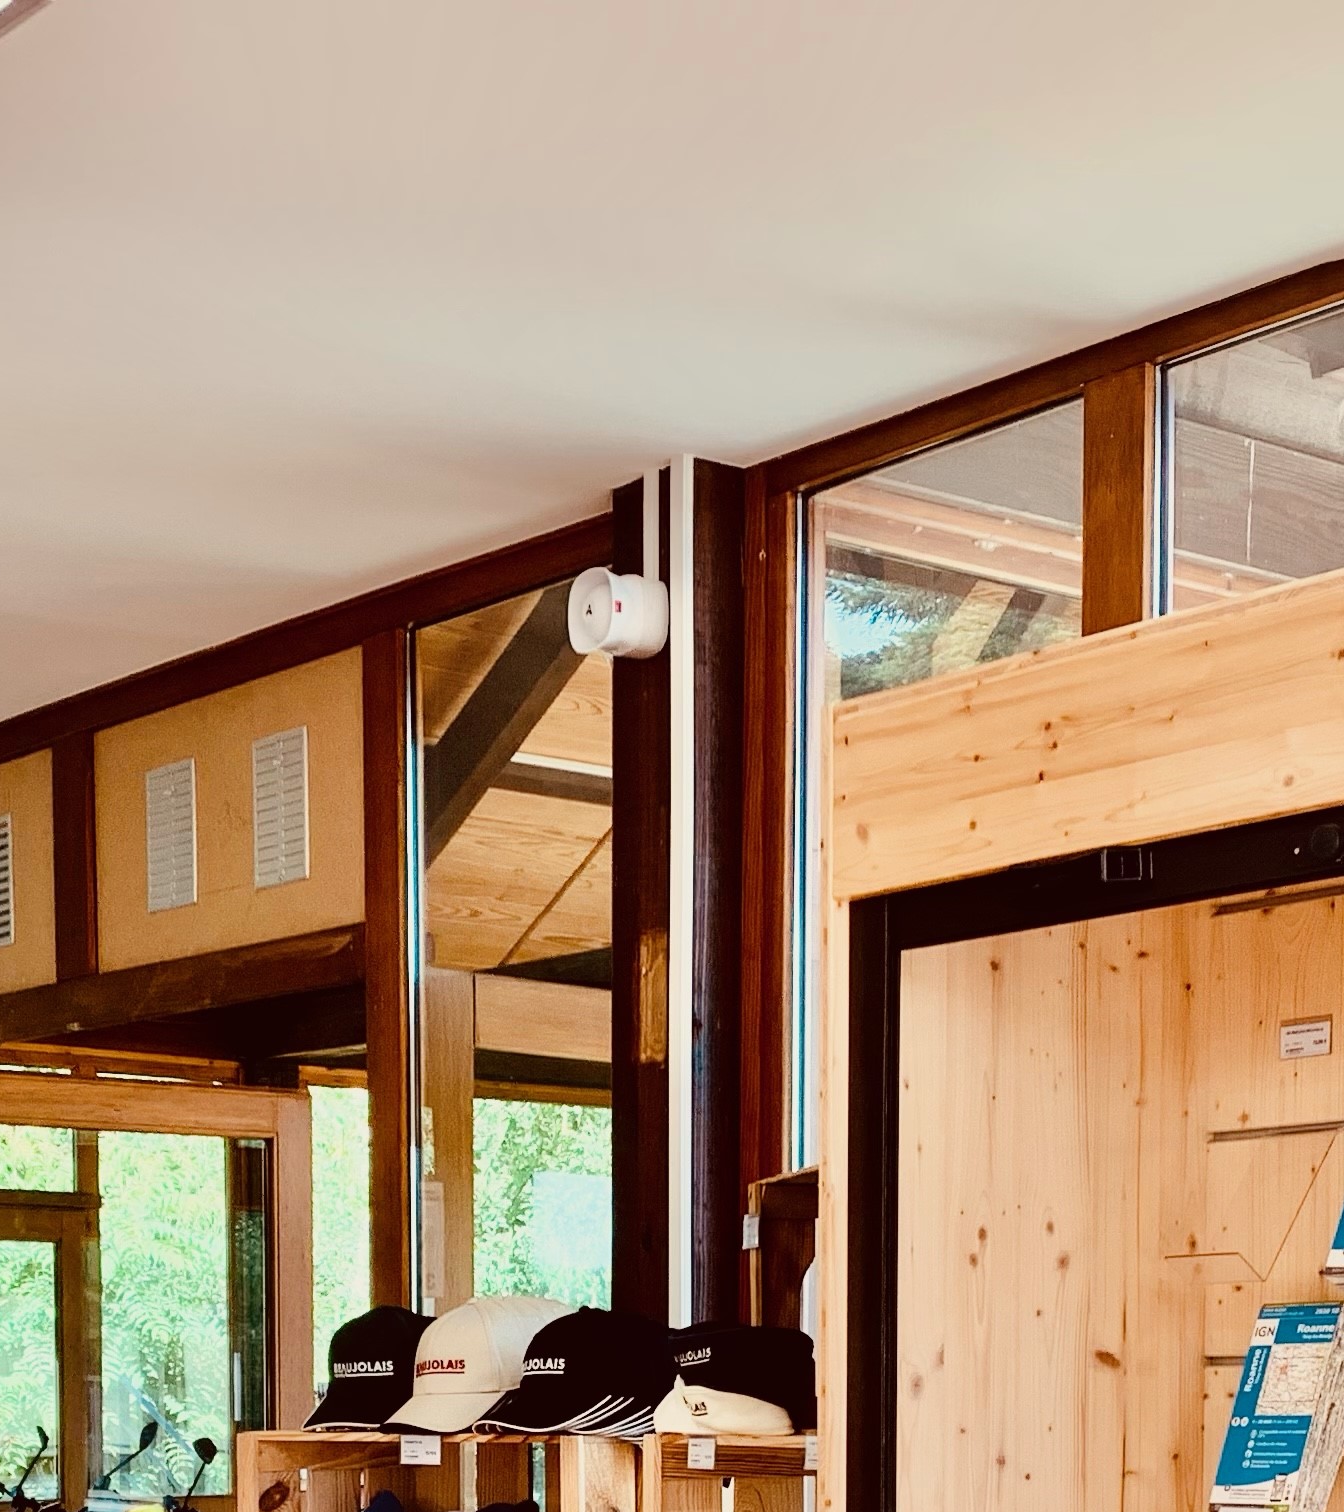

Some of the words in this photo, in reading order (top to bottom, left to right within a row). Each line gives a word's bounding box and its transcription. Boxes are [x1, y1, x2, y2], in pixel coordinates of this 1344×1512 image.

[1254, 1326, 1275, 1337] IGN
[1297, 1323, 1336, 1334] Roanne
[333, 1360, 394, 1374] BEAUJOLAIS
[1243, 1348, 1262, 1392] Roanne
